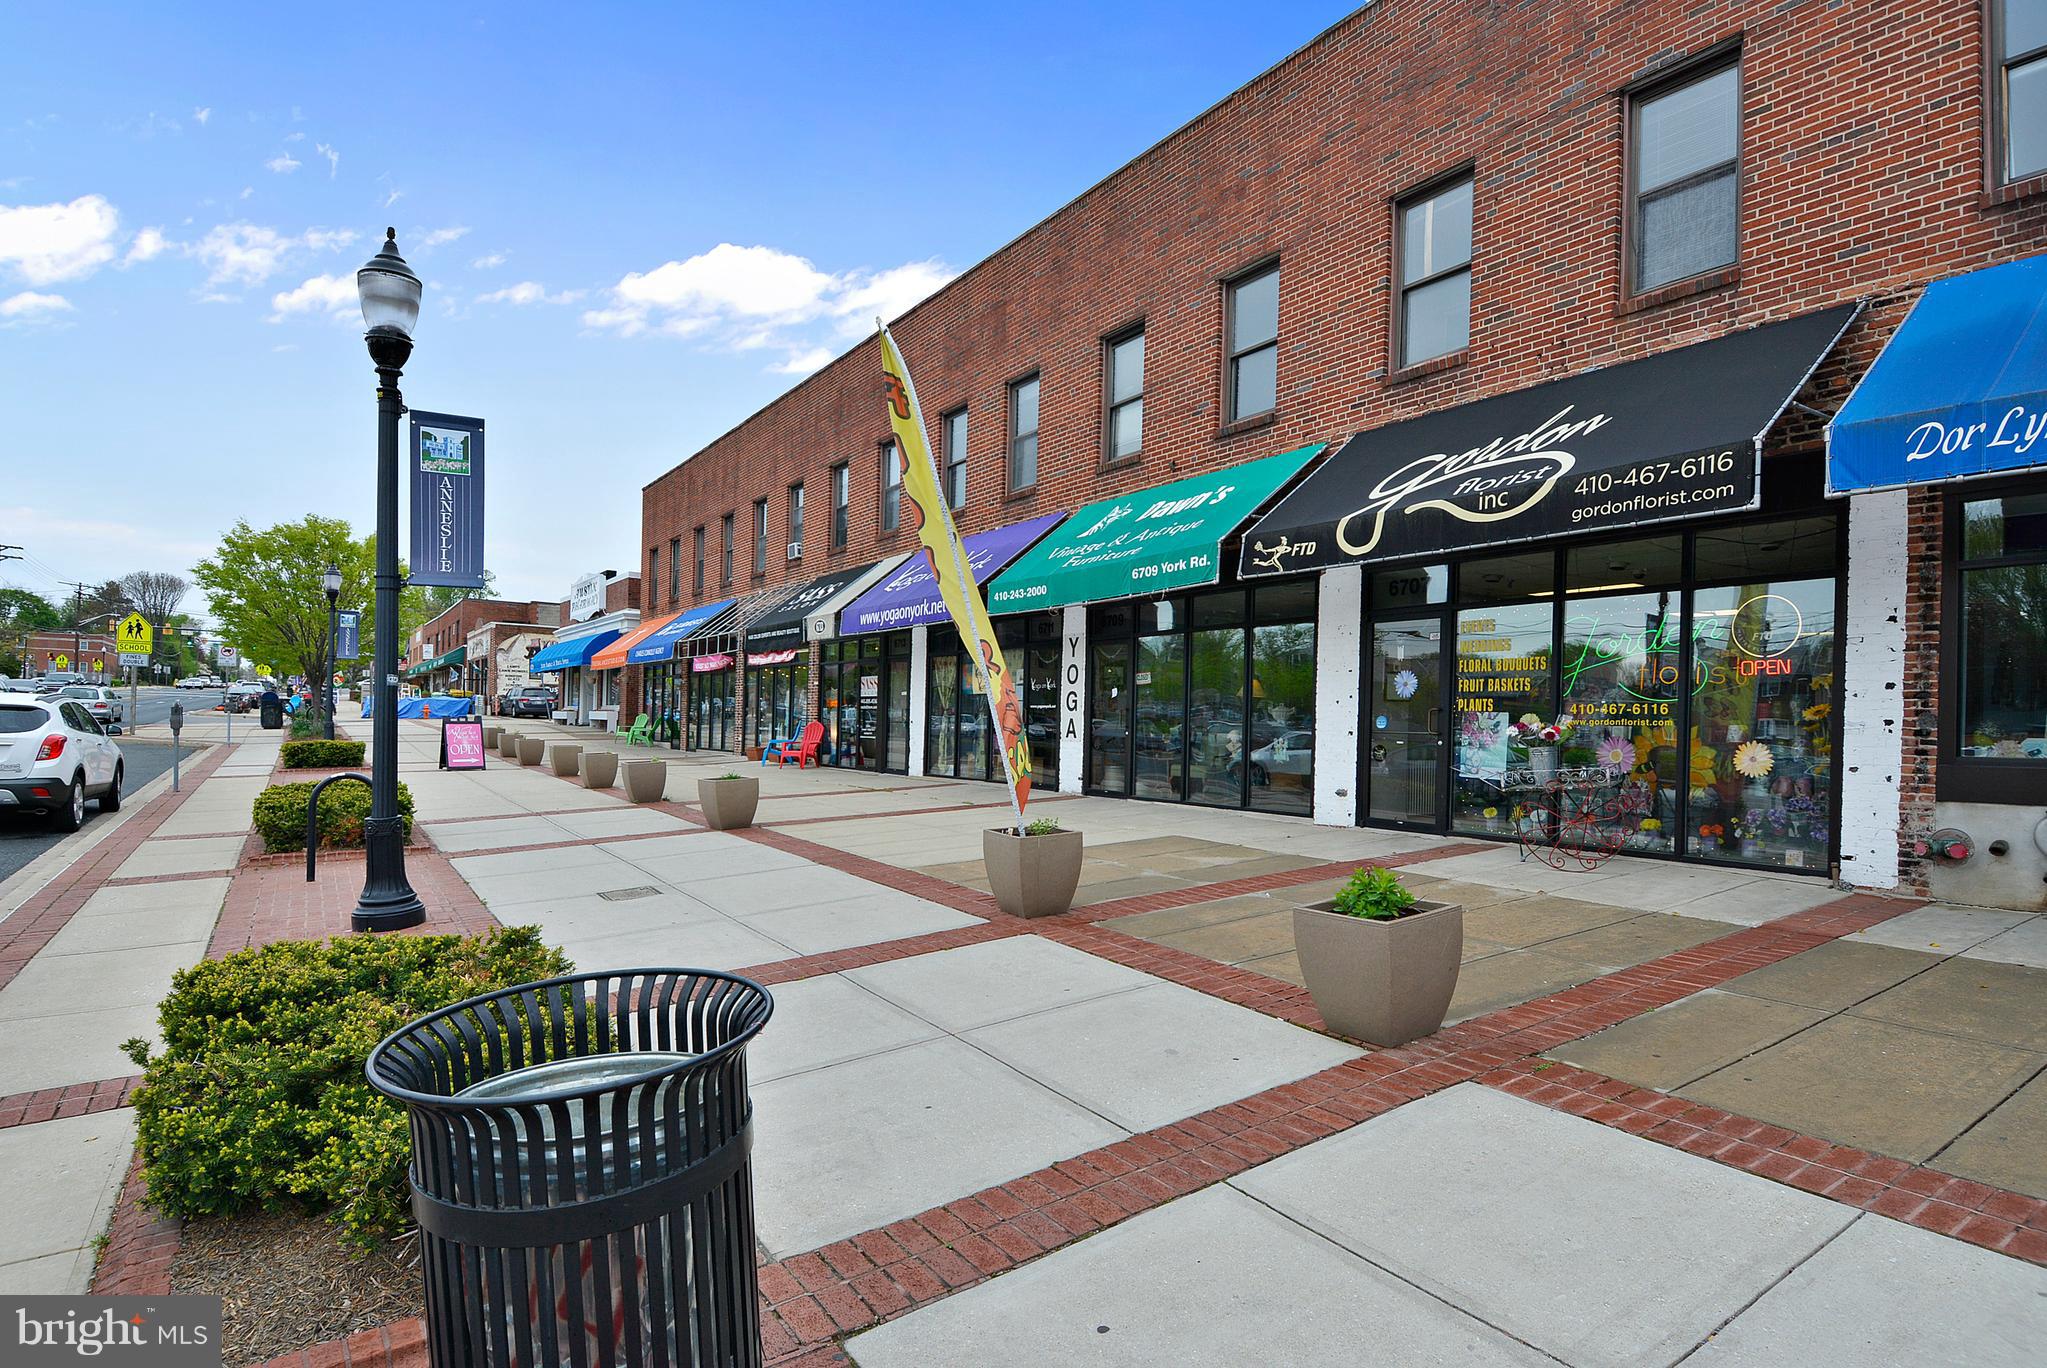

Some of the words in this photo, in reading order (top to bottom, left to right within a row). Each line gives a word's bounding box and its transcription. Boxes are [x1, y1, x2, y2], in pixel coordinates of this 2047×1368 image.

[1905, 421, 1987, 462] Dor
[1986, 406, 2047, 454] Ly
[1336, 404, 1613, 556] gordon
[1453, 464, 1553, 496] florist
[1574, 451, 1734, 496] 410-467-6116
[1135, 485, 1236, 523] Dawn's
[1478, 490, 1509, 511] inc
[1571, 484, 1735, 523] gordonflorist.com
[439, 476, 453, 573] ANNESLIE
[1291, 541, 1317, 557] FTD
[1132, 565, 1158, 580] 6709
[1161, 558, 1187, 574] York
[1190, 554, 1211, 569] Rd.
[994, 585, 1047, 601] 410-243-2000
[860, 599, 947, 626] www.yogaonyork.net
[119, 644, 149, 652] SCHOOL
[1459, 658, 1492, 673] FLORAL
[1495, 656, 1547, 671] BOUQUETS
[1741, 659, 1792, 676] OPEN
[1065, 637, 1080, 739] YOGA
[1458, 678, 1485, 692] FRUIT
[1488, 677, 1531, 692] BASKETS
[1458, 698, 1494, 712] PLANTS
[1569, 703, 1669, 715] 410-467-6116
[1570, 718, 1673, 727] www.gordonflorist.com
[450, 744, 480, 755] OPEN
